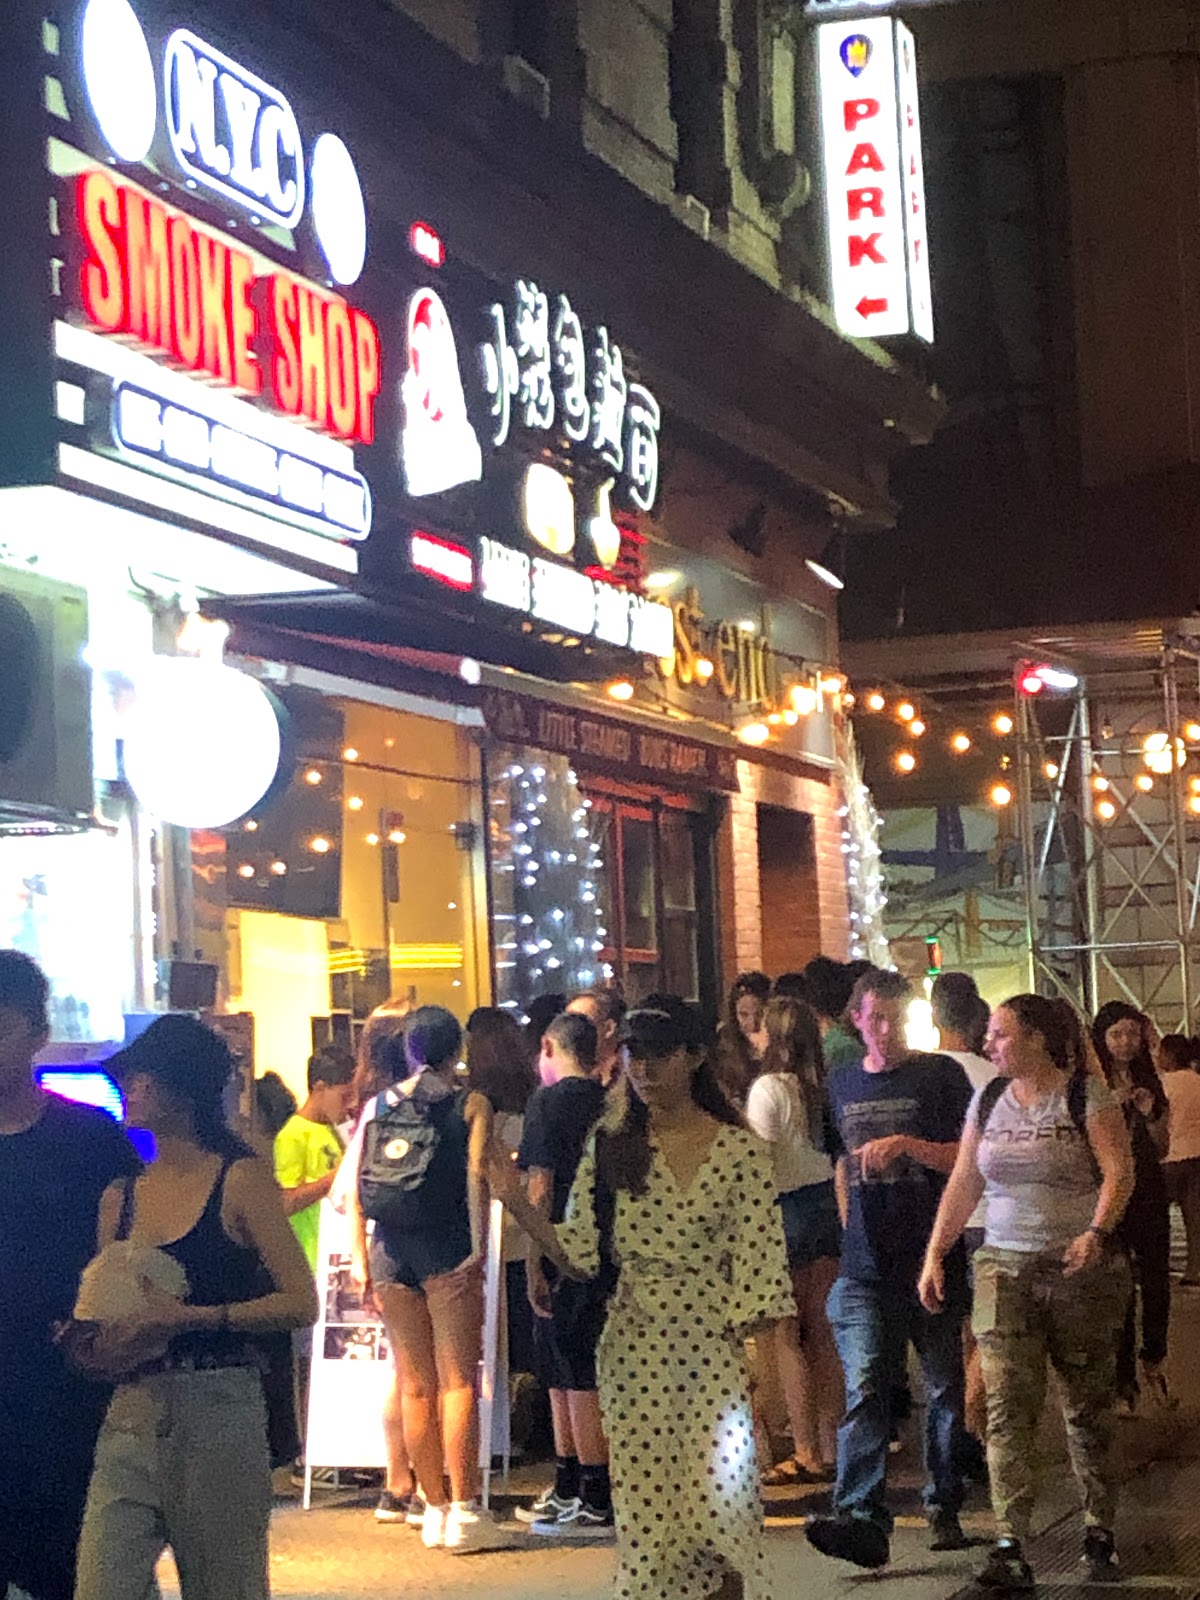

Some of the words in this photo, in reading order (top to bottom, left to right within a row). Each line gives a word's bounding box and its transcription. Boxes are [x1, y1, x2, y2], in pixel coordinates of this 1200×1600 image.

[174, 44, 298, 214] NYC
[843, 98, 888, 267] PARK
[79, 169, 263, 395] SMOKE
[269, 272, 381, 445] SHOP
